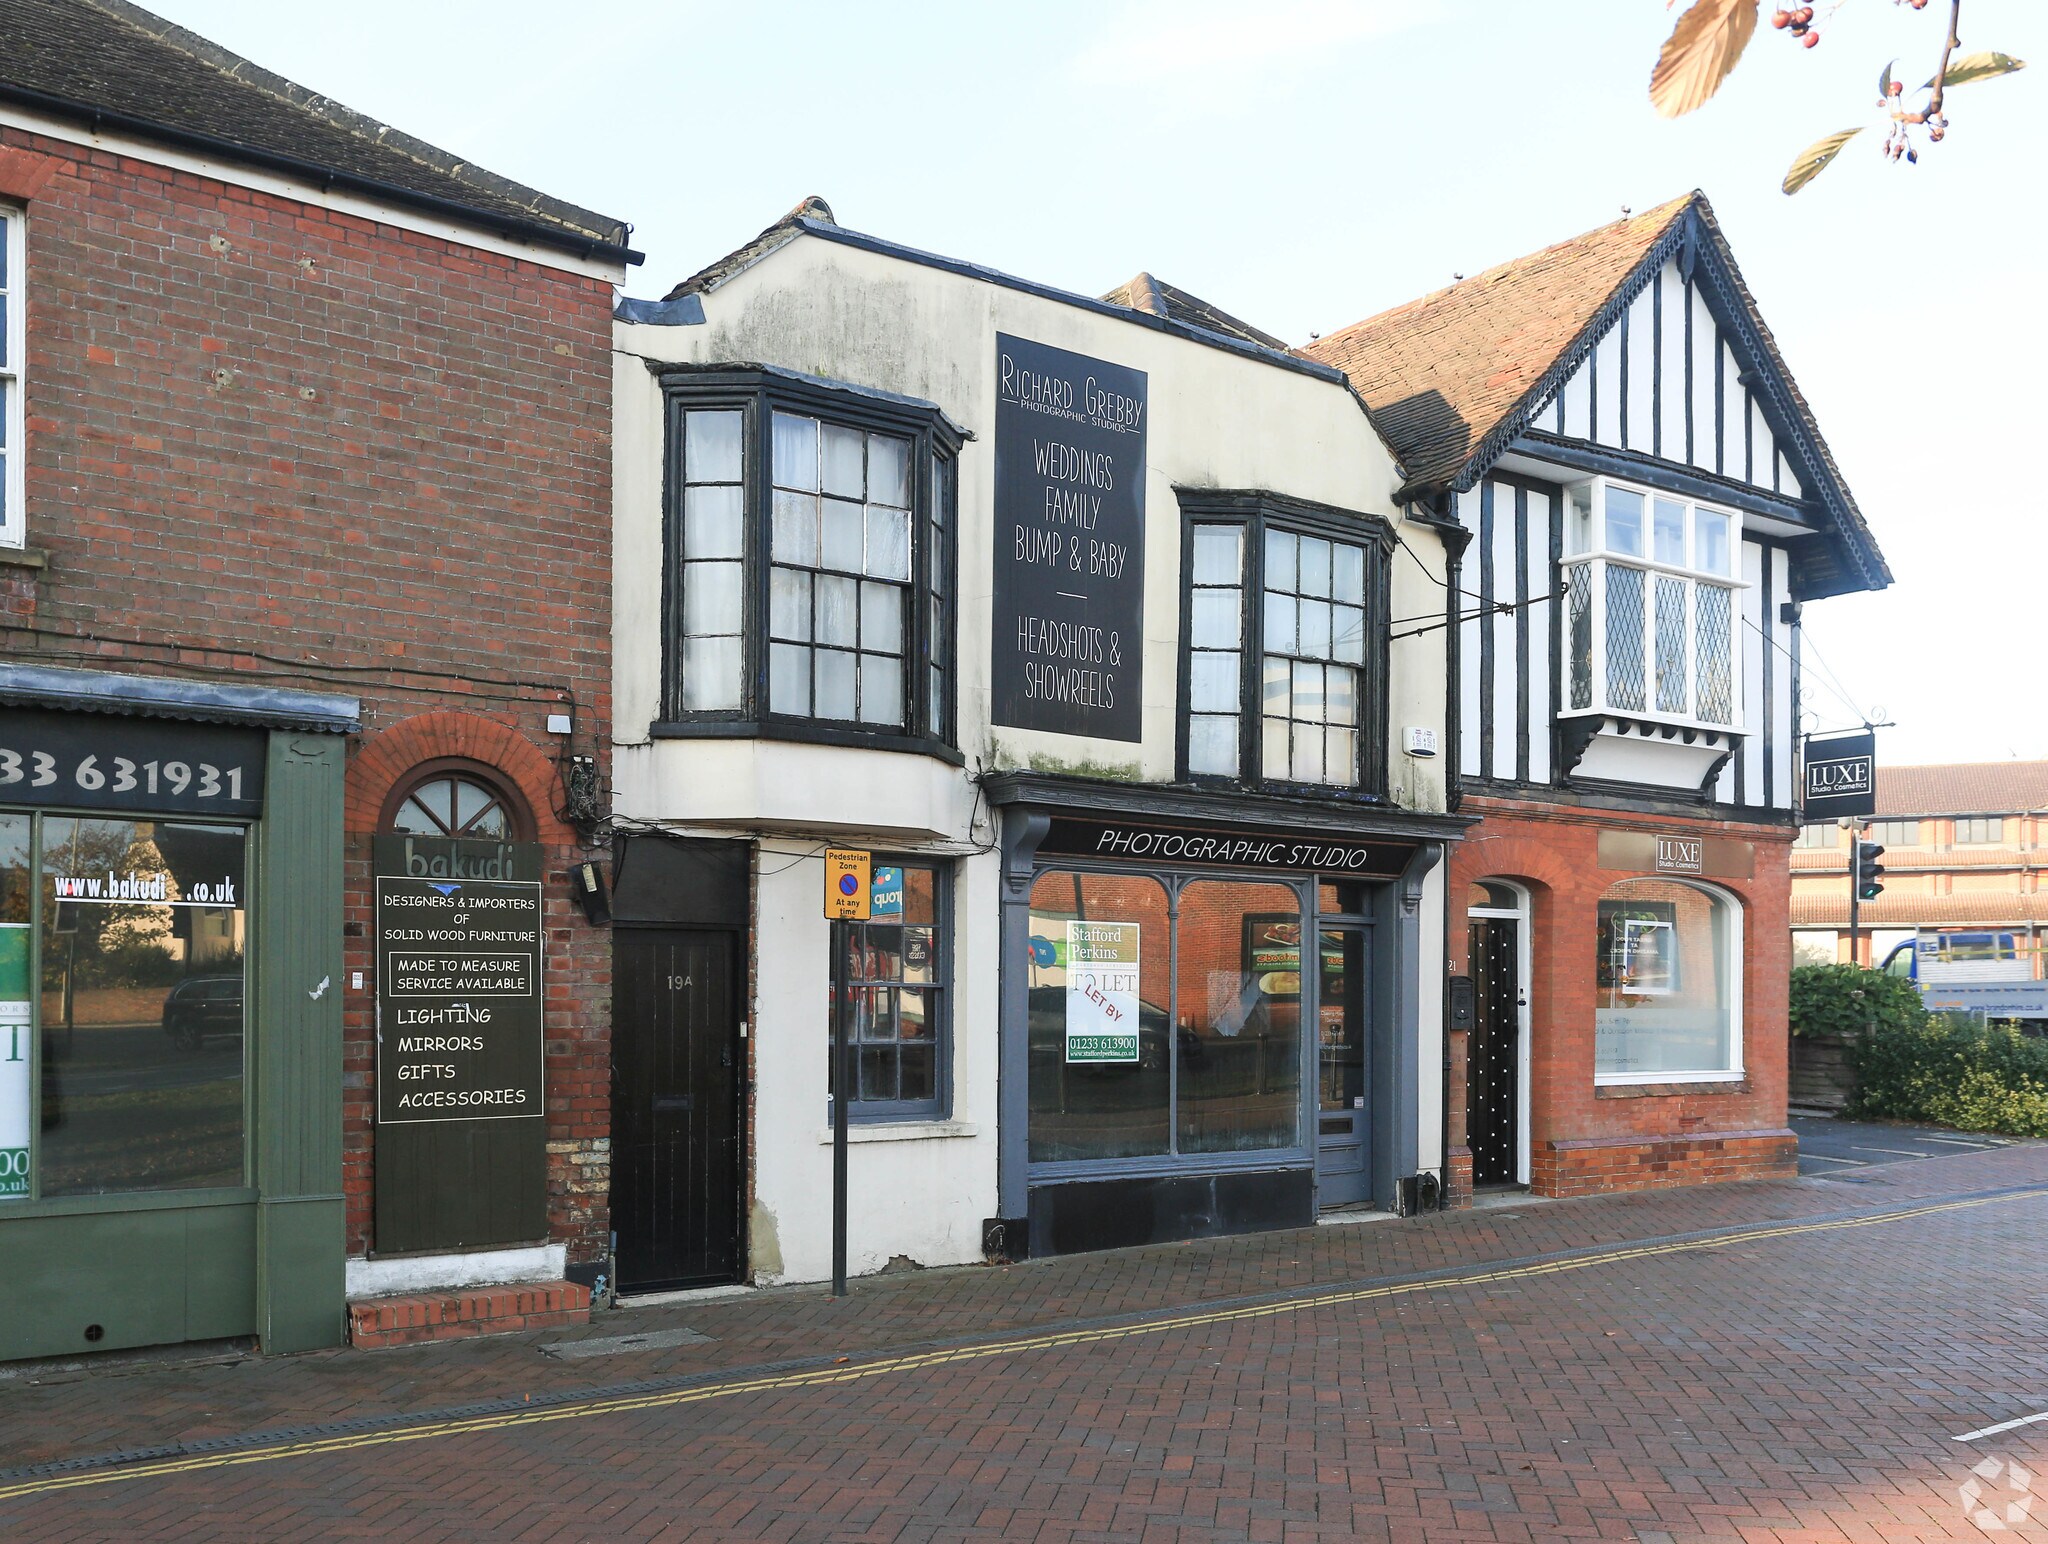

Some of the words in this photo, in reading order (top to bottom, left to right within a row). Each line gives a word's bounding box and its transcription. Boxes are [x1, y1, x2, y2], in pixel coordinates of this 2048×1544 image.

[1021, 400, 1087, 423] PHOTOGRAPHIC
[1091, 417, 1126, 433] STUDIOS
[1034, 438, 1113, 491] WEDDINGS
[1045, 486, 1101, 530] FAMILY
[1016, 524, 1062, 567] BUMP
[1069, 536, 1082, 572] &
[1090, 539, 1127, 579] BABY
[1018, 616, 1103, 663] HEADSHOTS
[1109, 631, 1122, 667] &
[1025, 662, 1114, 709] SHOWREELS
[0, 748, 58, 787] 33
[75, 754, 242, 800] 631931
[1811, 762, 1867, 786] LUXE
[1834, 782, 1867, 791] Cosmetics
[1096, 830, 1286, 863] PHOTOGRAPHIC
[1286, 845, 1367, 868] STUDIO
[1659, 840, 1700, 863] LUXE
[405, 837, 513, 880] bakudi
[829, 852, 868, 862] Pedestrian
[839, 862, 858, 870] Zone
[1676, 861, 1699, 869] Cosmetics
[55, 871, 167, 899] www.bakudi
[384, 895, 455, 908] DESIGNERS
[457, 897, 466, 908] &
[469, 897, 536, 910] IMPORTERS
[836, 898, 845, 906] At
[847, 900, 860, 908] any
[454, 914, 470, 924] OF
[384, 930, 424, 941] SOLID
[427, 930, 466, 941] WOOD
[469, 930, 536, 942] FURNITURE
[1071, 927, 1122, 942] Stafford
[1071, 944, 1118, 959] Perkins
[398, 960, 436, 971] MADE
[440, 960, 457, 971] TO
[461, 960, 520, 972] MEASURE
[397, 978, 452, 989] SERVICE
[456, 978, 525, 989] AVAILABLE
[667, 975, 693, 990] 19A
[1101, 974, 1136, 992] LET
[1085, 984, 1108, 1007] LET
[1105, 1004, 1123, 1022] BY
[397, 1008, 492, 1024] LIGHTING
[398, 1037, 484, 1052] MIRRORS
[1069, 1038, 1099, 1050] 01233
[1101, 1038, 1135, 1050] 613900
[398, 1065, 456, 1080] GIFTS
[399, 1089, 526, 1108] ACCESSORIES
